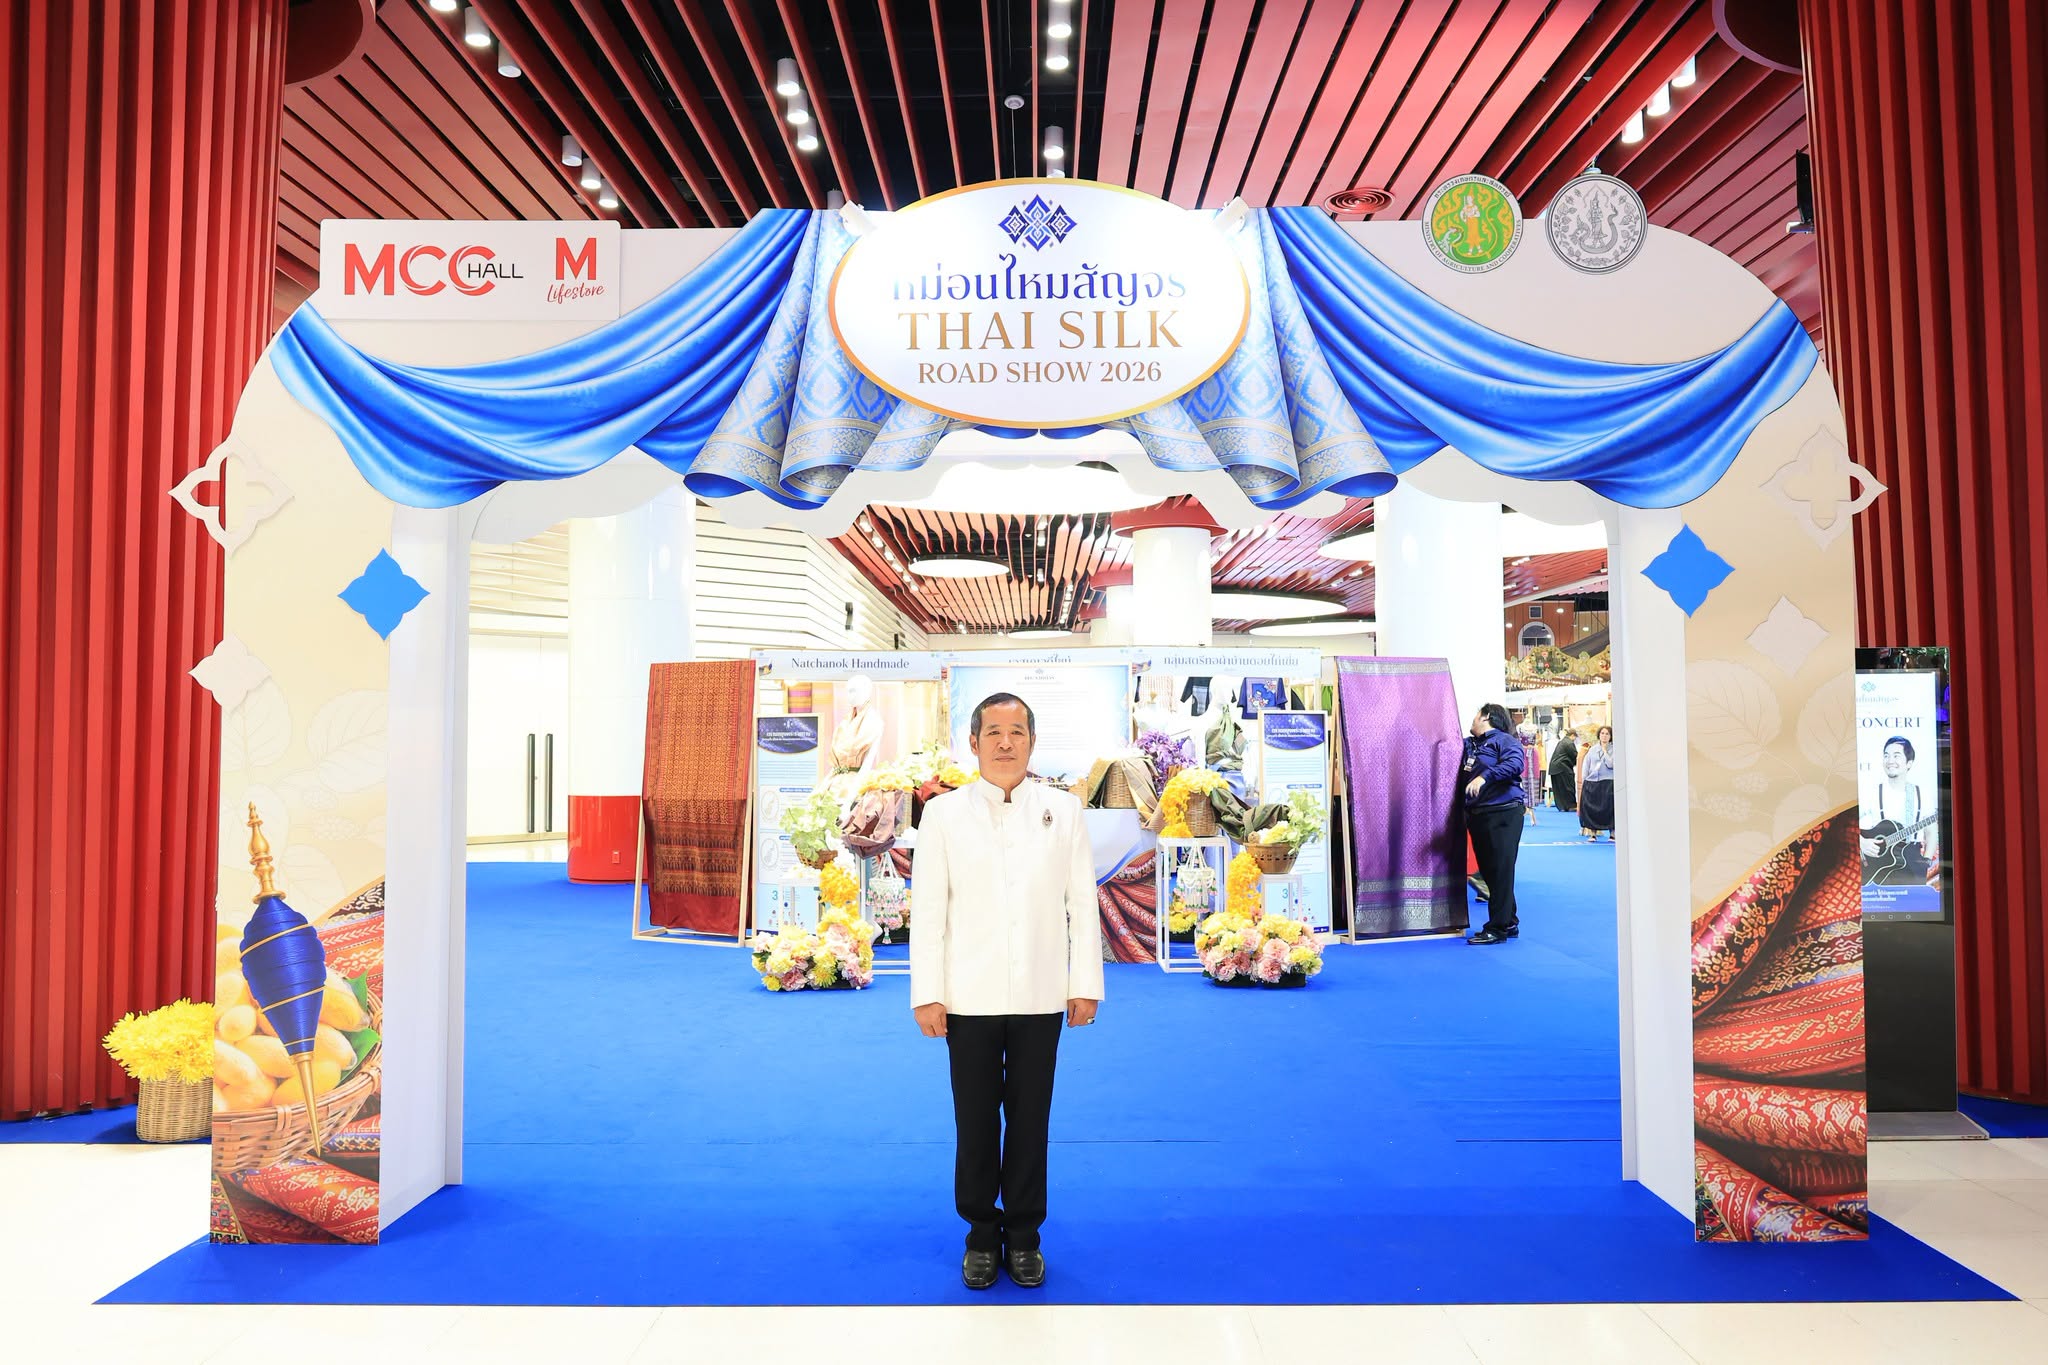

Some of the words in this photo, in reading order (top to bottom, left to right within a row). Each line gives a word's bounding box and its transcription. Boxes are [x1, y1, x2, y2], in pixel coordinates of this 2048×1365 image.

[555, 237, 597, 280] M
[1442, 257, 1485, 272] AGRICULTURE
[1486, 260, 1499, 270] AND
[1499, 219, 1521, 263] COOPERATIVES
[344, 243, 496, 296] MCC
[467, 263, 524, 278] HALL
[546, 282, 605, 304] Lifestore
[898, 311, 1034, 351] THAI
[1058, 310, 1183, 350] SILK
[918, 362, 998, 384] ROAD
[1006, 361, 1093, 383] SHOW
[1100, 360, 1162, 383] 2026
[791, 657, 849, 669] Natchanok
[851, 657, 910, 669] Handmade
